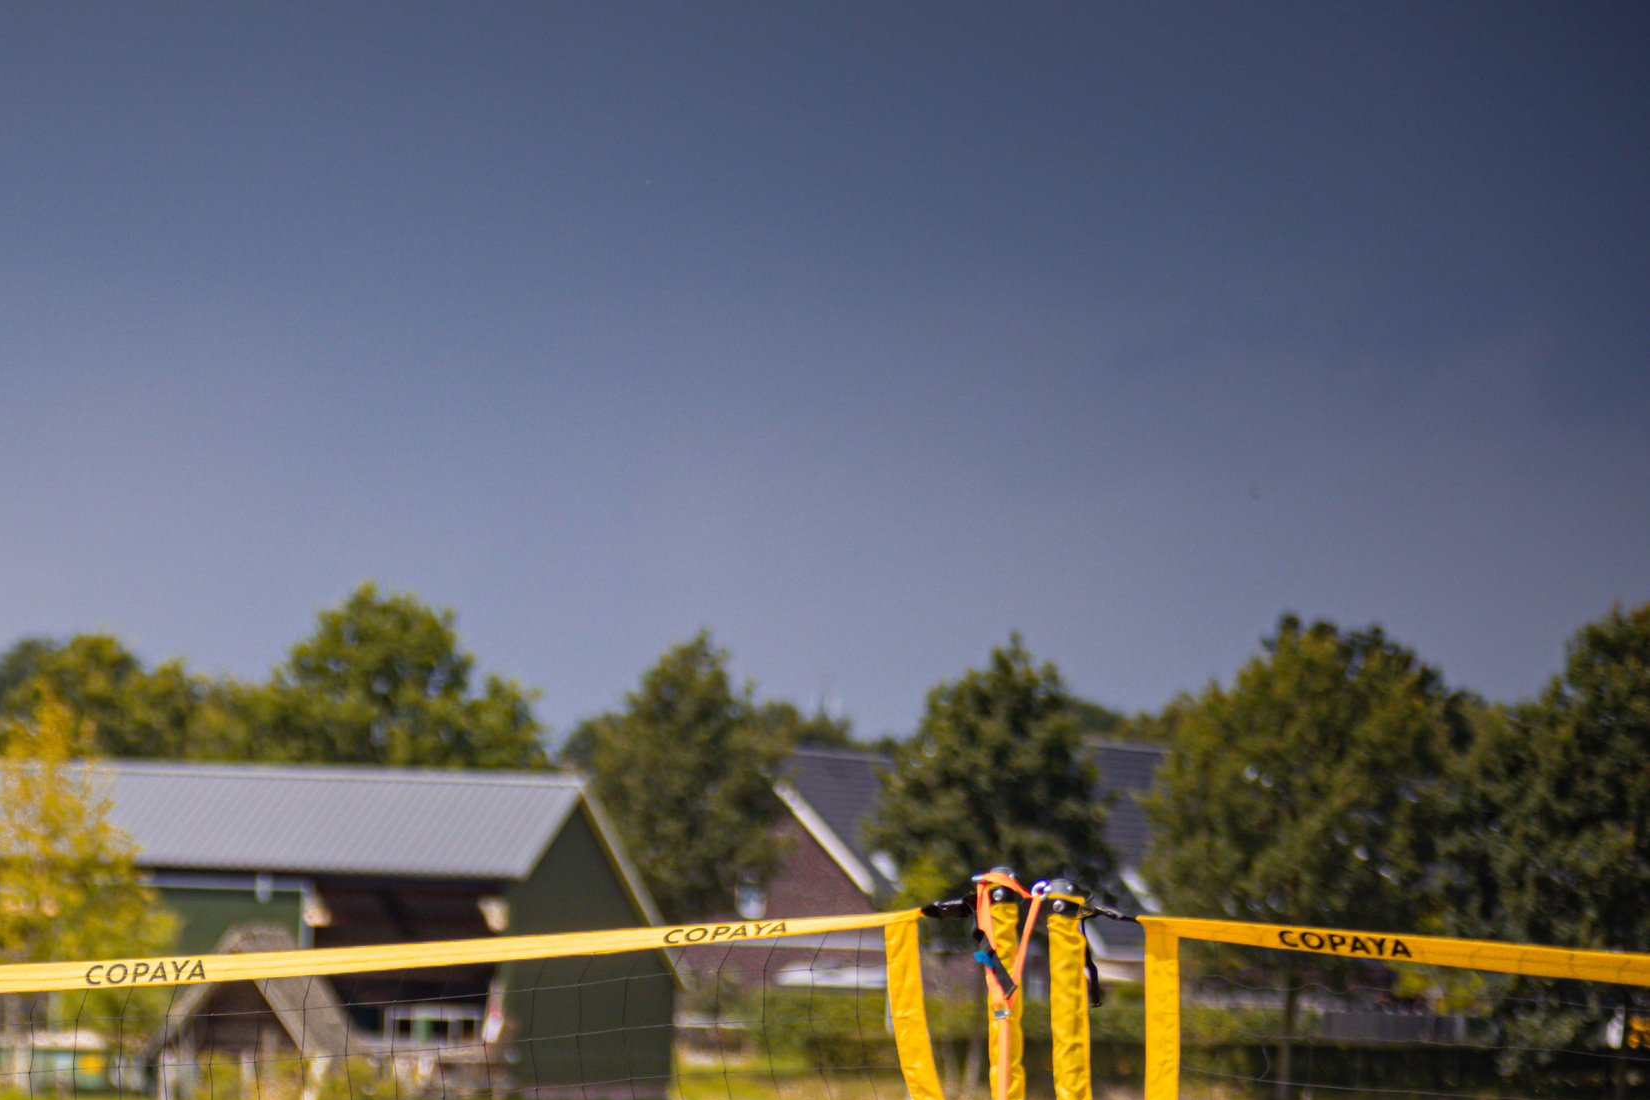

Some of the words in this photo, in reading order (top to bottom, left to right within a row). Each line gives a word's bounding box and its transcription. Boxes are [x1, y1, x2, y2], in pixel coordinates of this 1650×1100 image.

[663, 922, 787, 945] COPAYA
[1278, 931, 1412, 958] COPAYA
[85, 959, 206, 985] COPAYA
